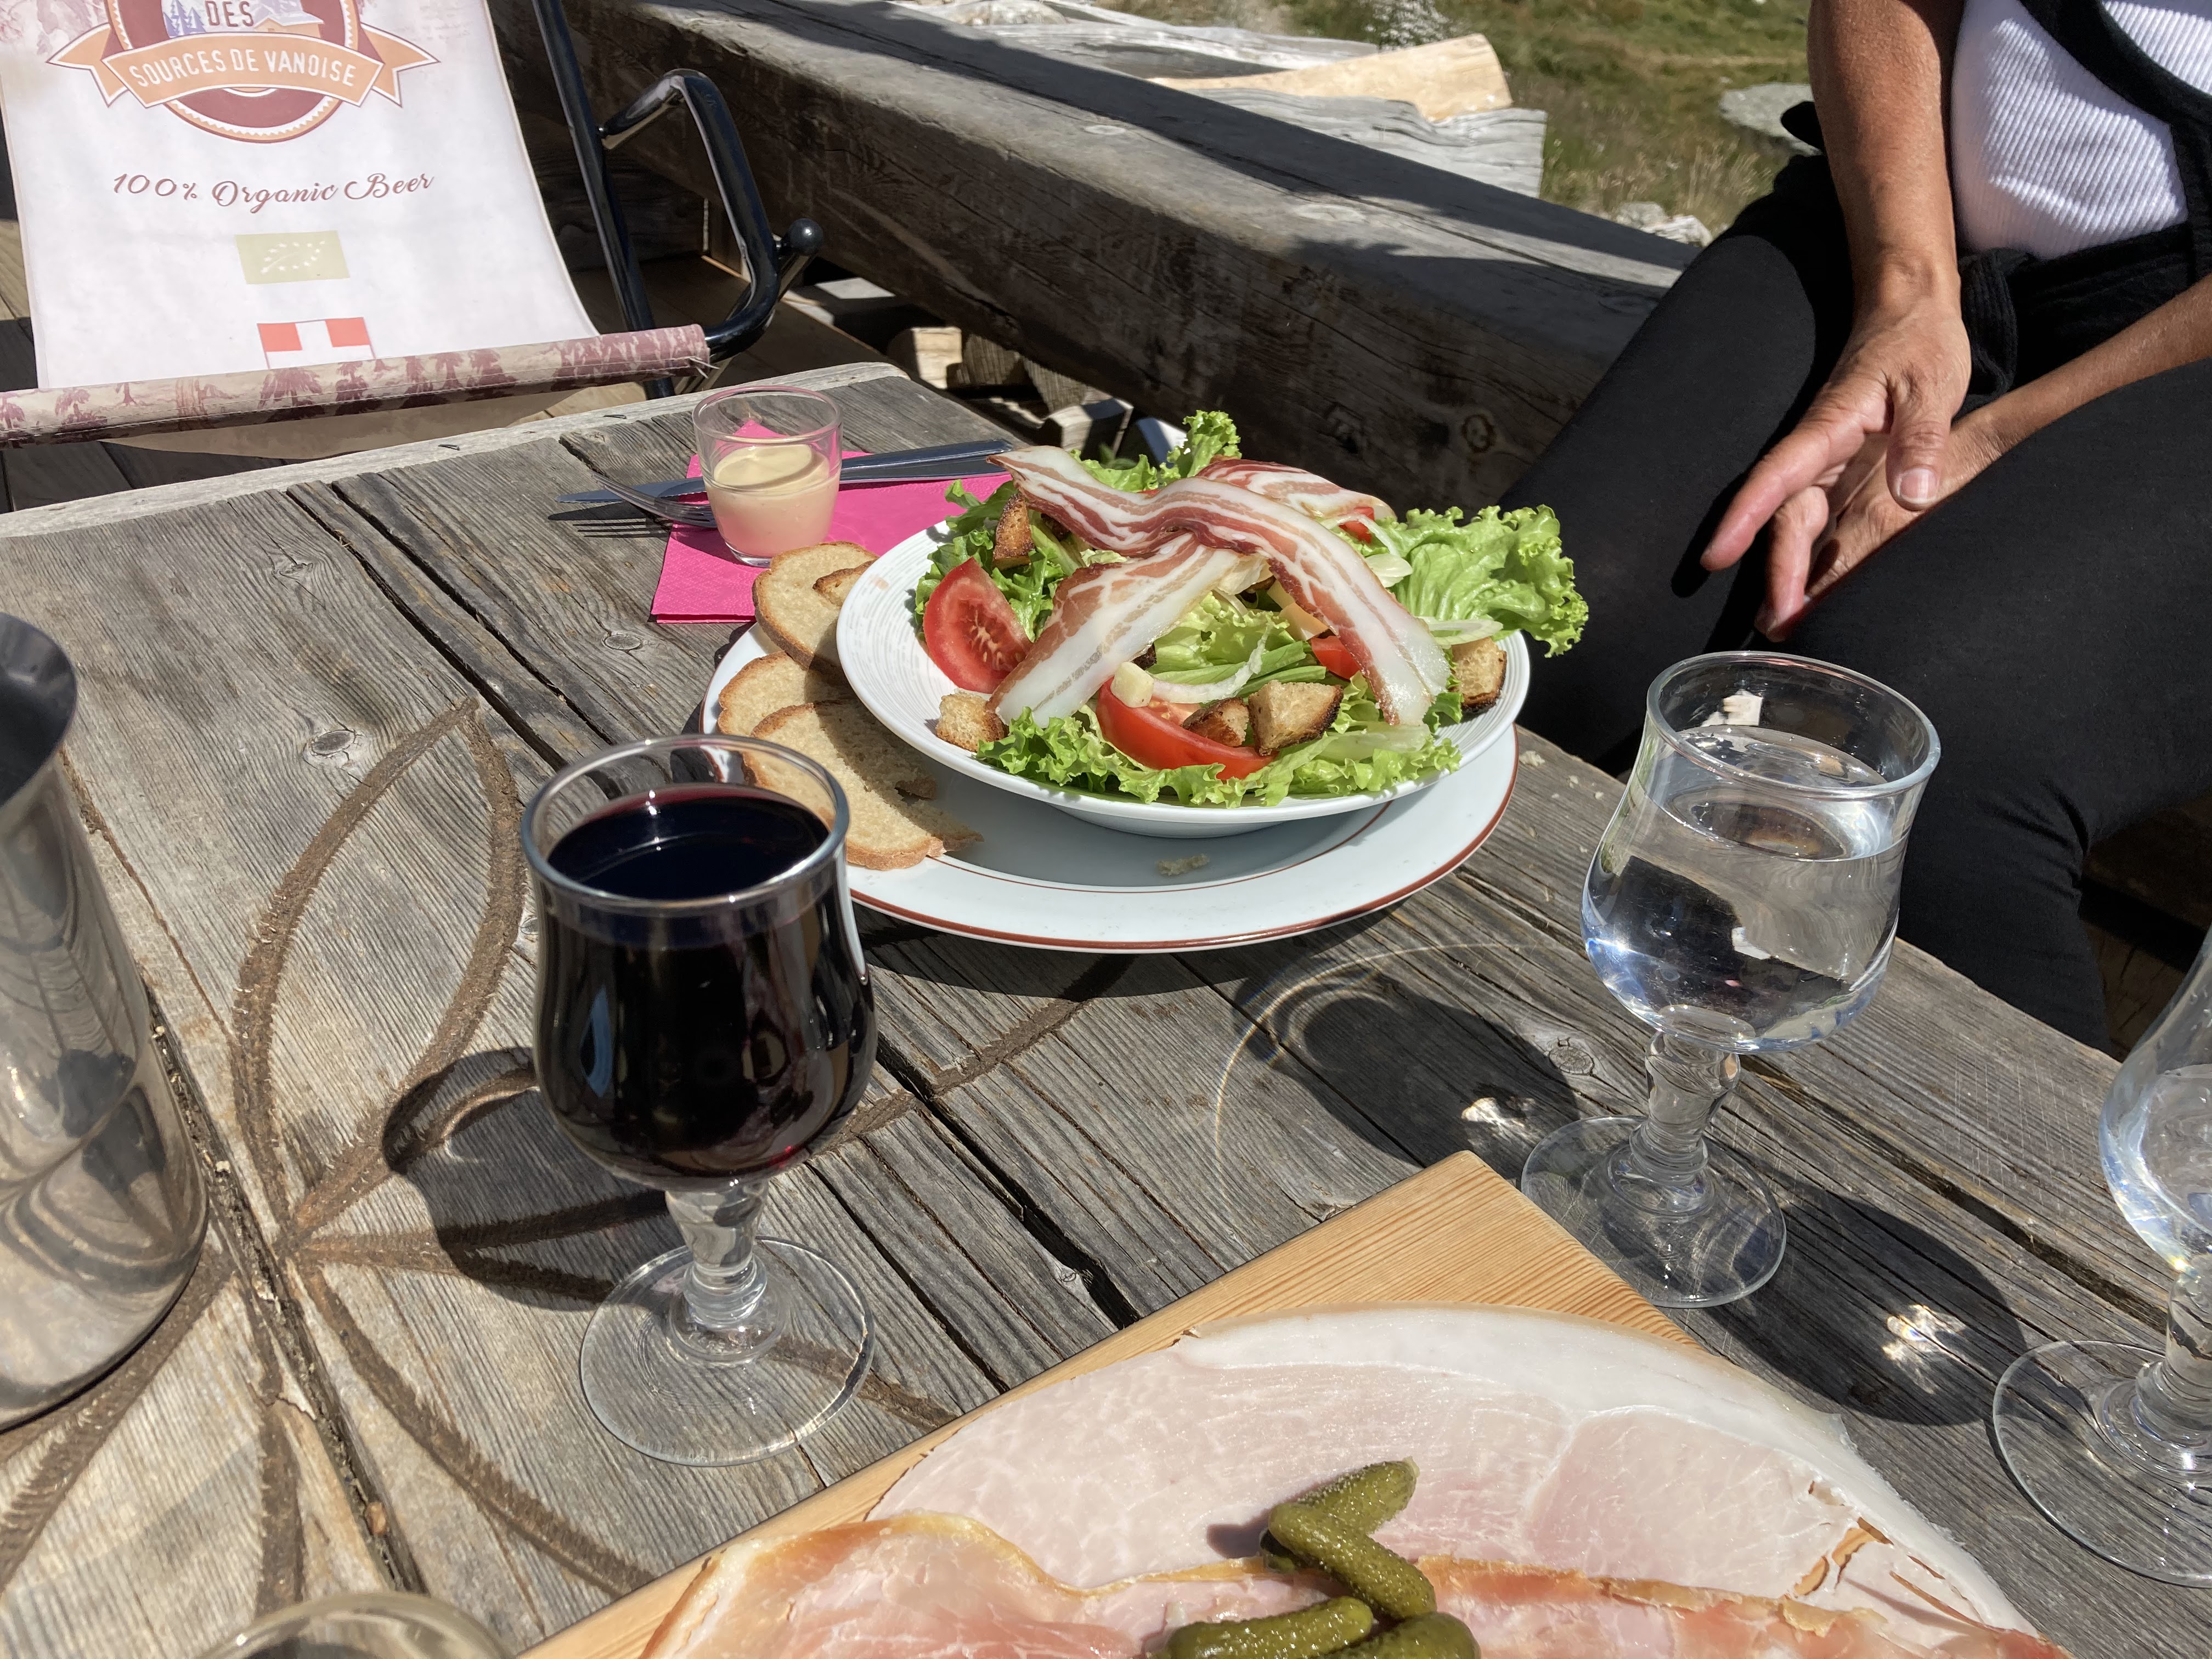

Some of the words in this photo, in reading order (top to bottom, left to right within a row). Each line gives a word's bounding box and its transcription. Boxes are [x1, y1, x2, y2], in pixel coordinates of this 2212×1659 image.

[205, 0, 254, 27] DES
[128, 50, 227, 88] SOURCES
[229, 48, 259, 72] DE
[263, 49, 358, 87] VANOISE
[113, 173, 198, 200] 100%
[211, 180, 338, 214] Organic
[343, 172, 435, 200] Beer
